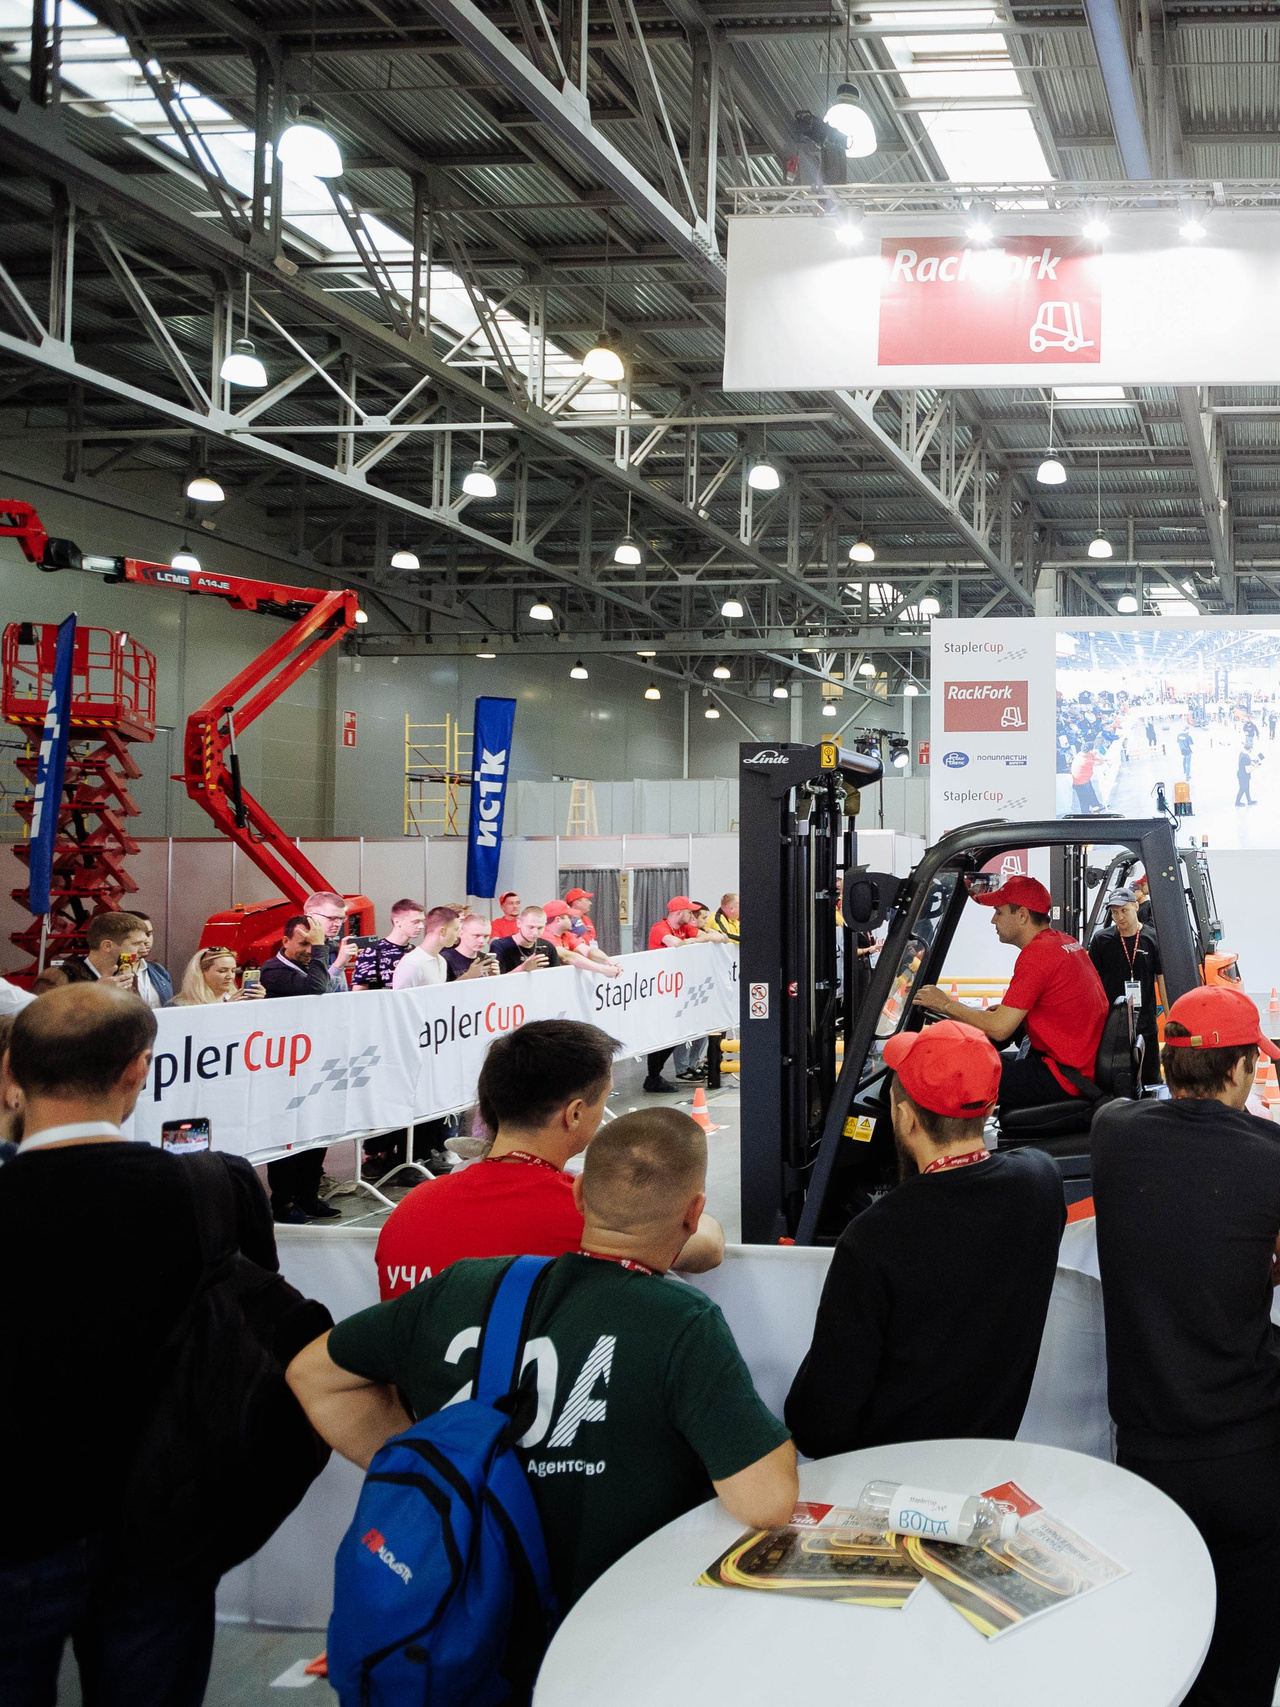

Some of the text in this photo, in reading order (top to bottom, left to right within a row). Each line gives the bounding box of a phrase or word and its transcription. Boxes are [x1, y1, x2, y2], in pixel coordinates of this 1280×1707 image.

[197, 578, 230, 590] A14JE
[943, 642, 1004, 655] StaplerCup
[947, 685, 1012, 700] RackFork
[743, 750, 789, 764] Linde
[474, 748, 507, 847] ИСТК
[943, 790, 1003, 803] StaplerCup
[595, 970, 684, 1011] StaplerCup
[142, 1031, 312, 1102] plerCup
[387, 1265, 444, 1290] УЧА
[899, 1510, 949, 1536] ВОДА
